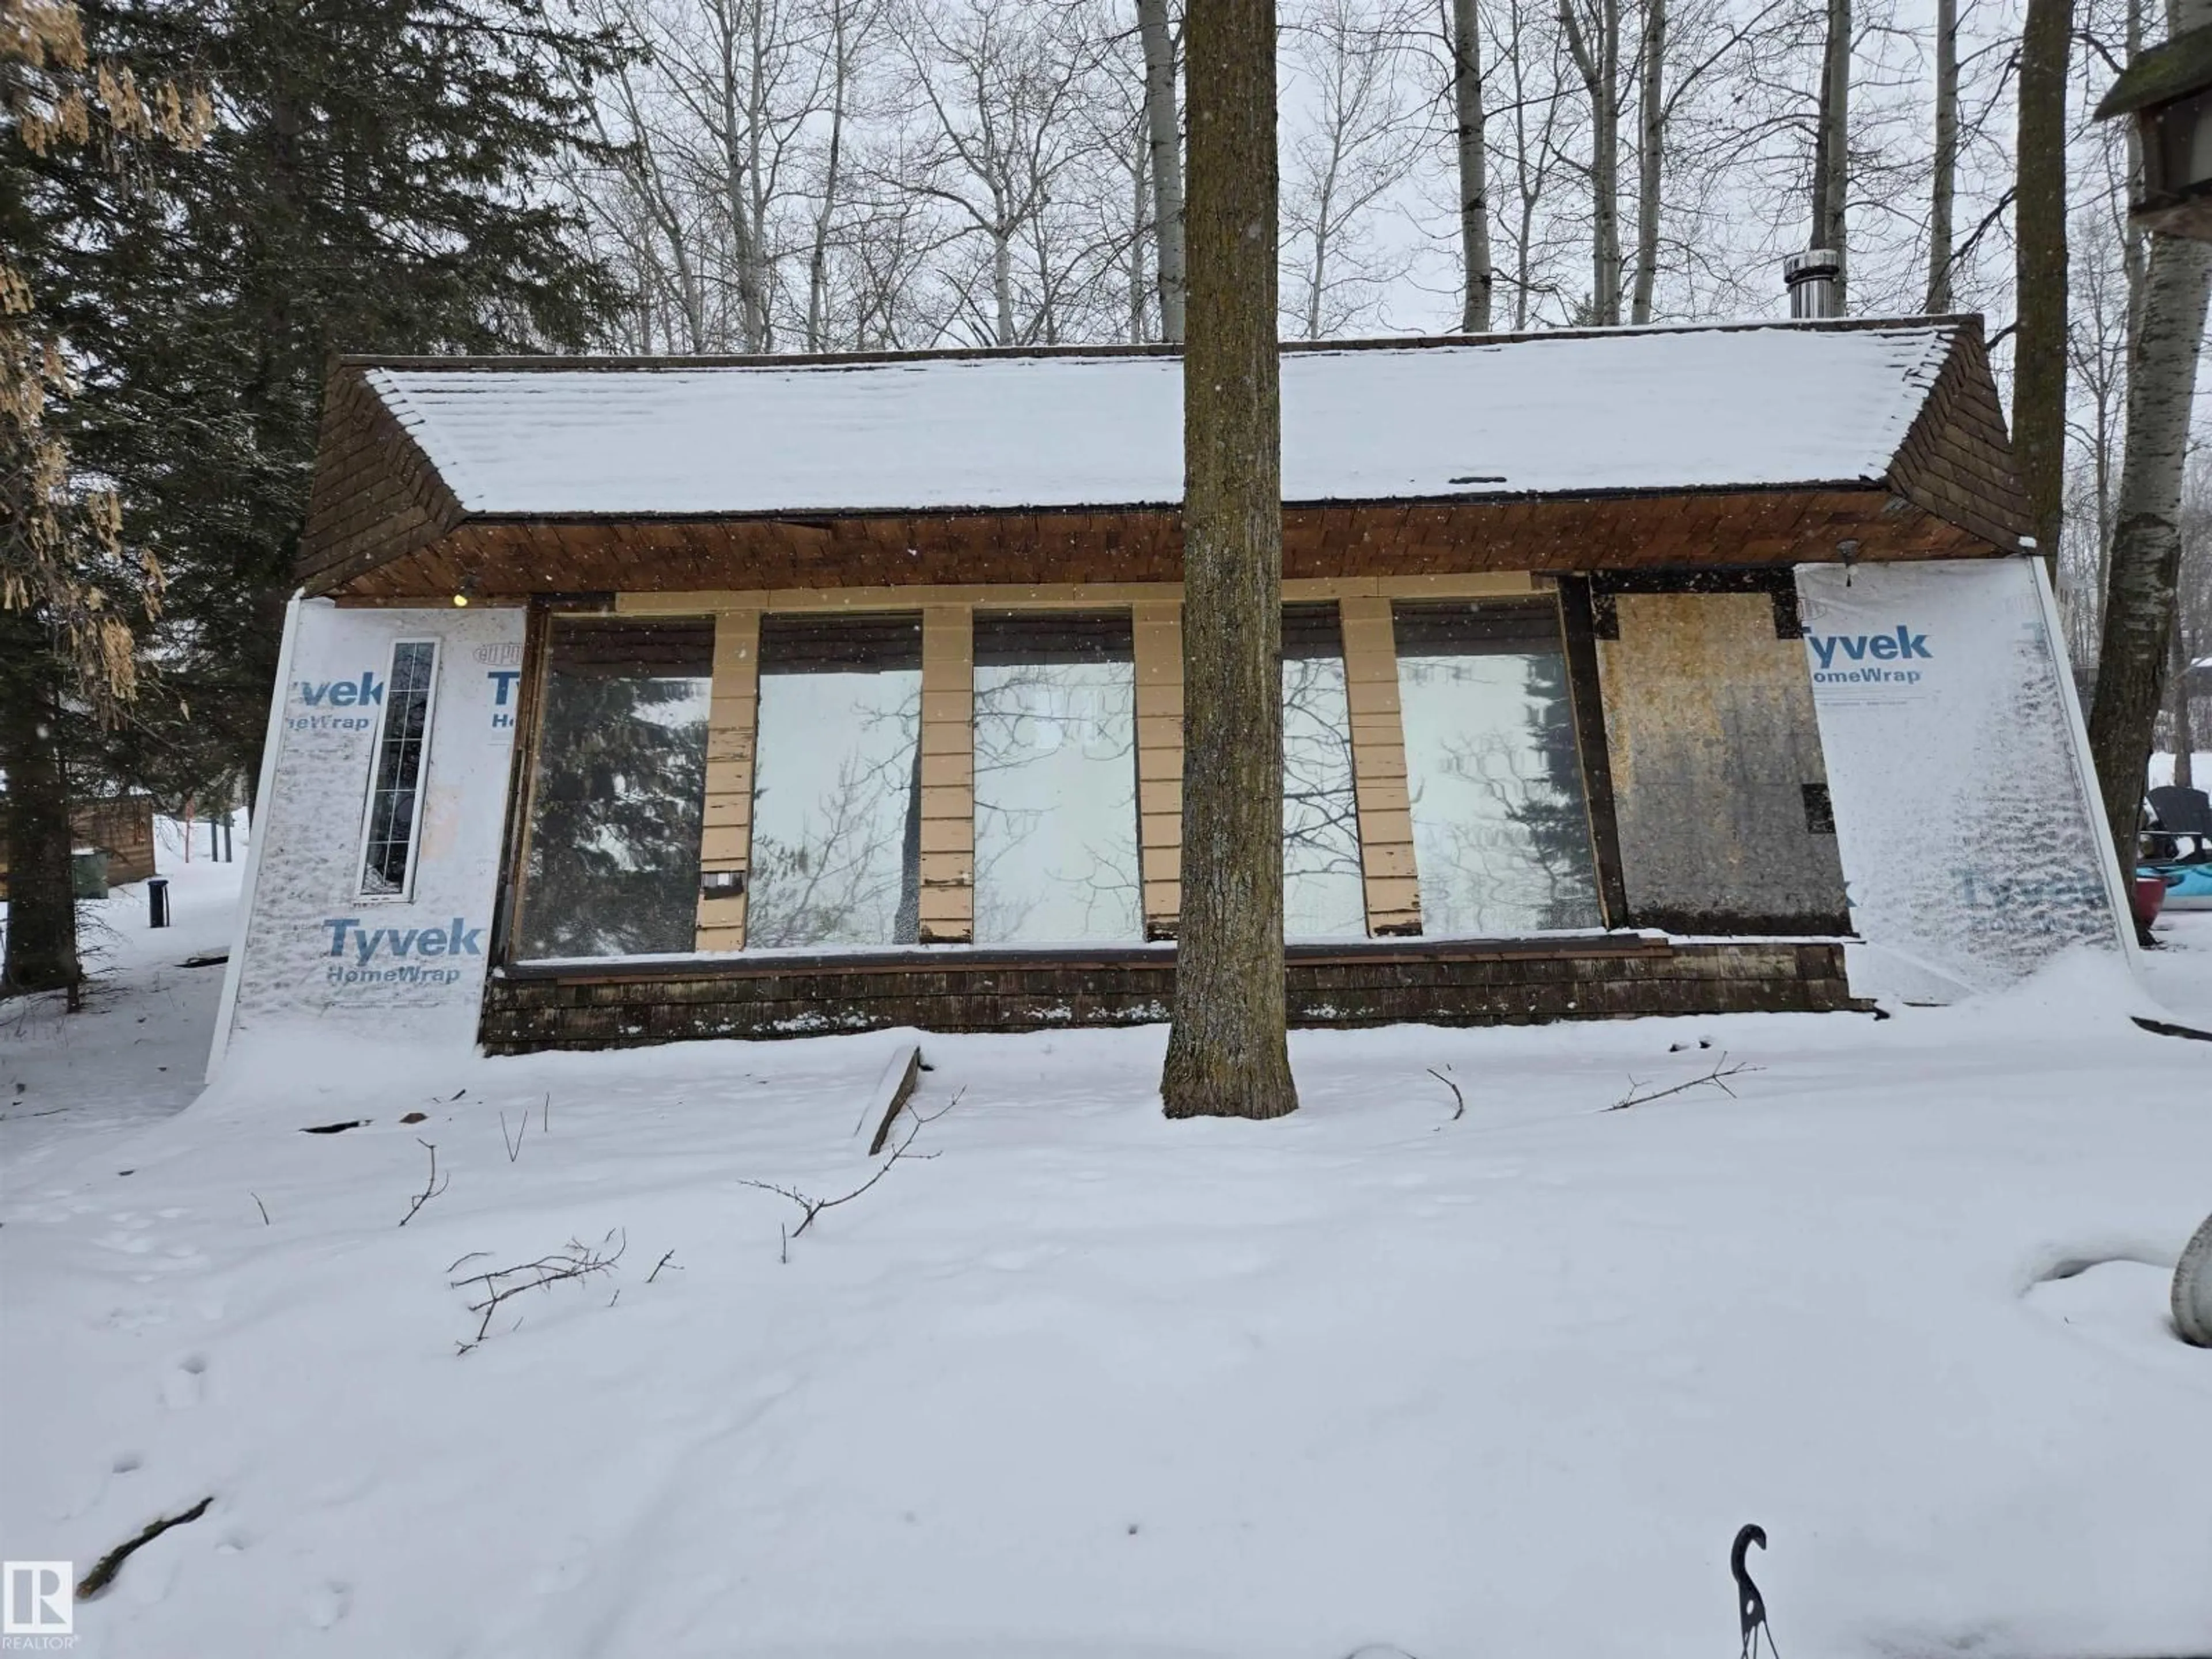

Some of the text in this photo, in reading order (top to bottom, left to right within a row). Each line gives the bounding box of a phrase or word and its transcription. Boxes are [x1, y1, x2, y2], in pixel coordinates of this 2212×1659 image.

[1803, 624, 1934, 669] yvek
[293, 672, 384, 706] vek
[487, 672, 521, 705] T
[324, 918, 486, 966] Tyvek
[326, 965, 460, 984] HomeWrap
